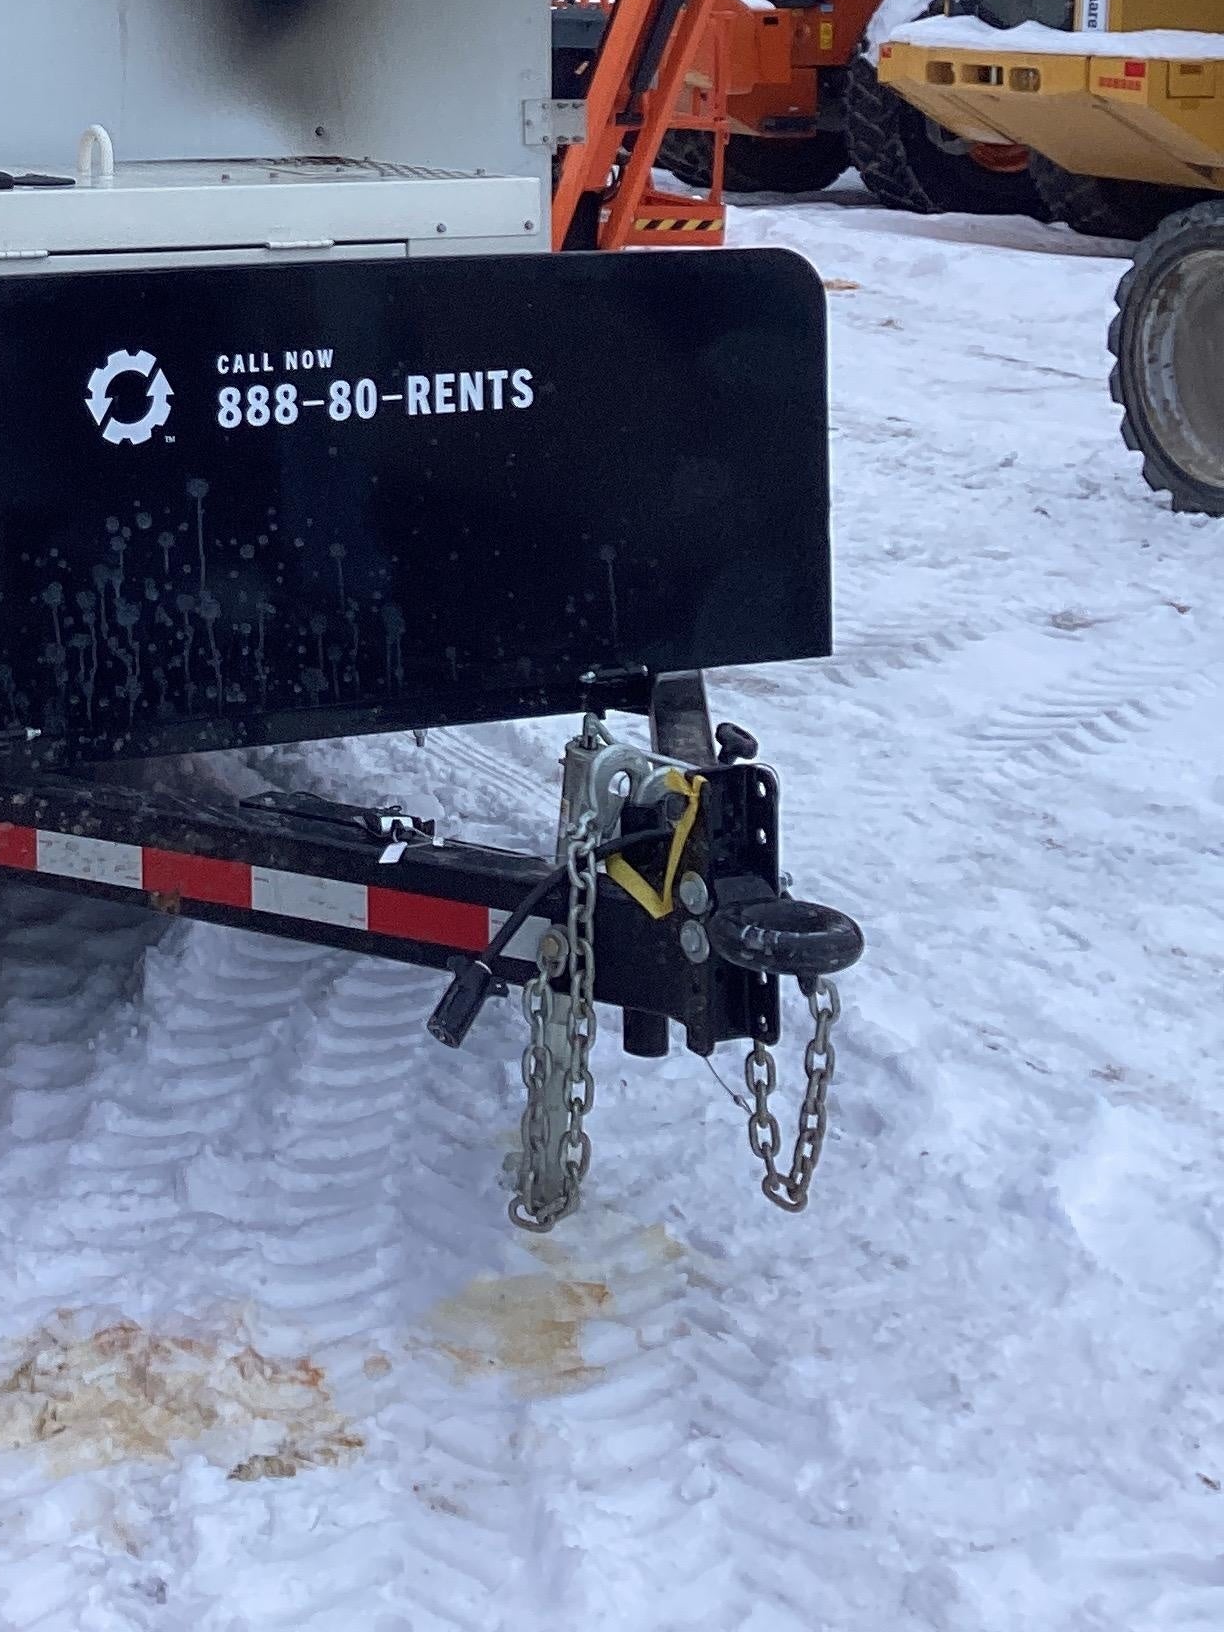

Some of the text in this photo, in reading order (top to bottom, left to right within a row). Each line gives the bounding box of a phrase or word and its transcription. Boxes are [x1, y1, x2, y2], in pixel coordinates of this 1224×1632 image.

[217, 348, 334, 374] CALL NOW
[217, 367, 534, 429] 888-80-RENTS
